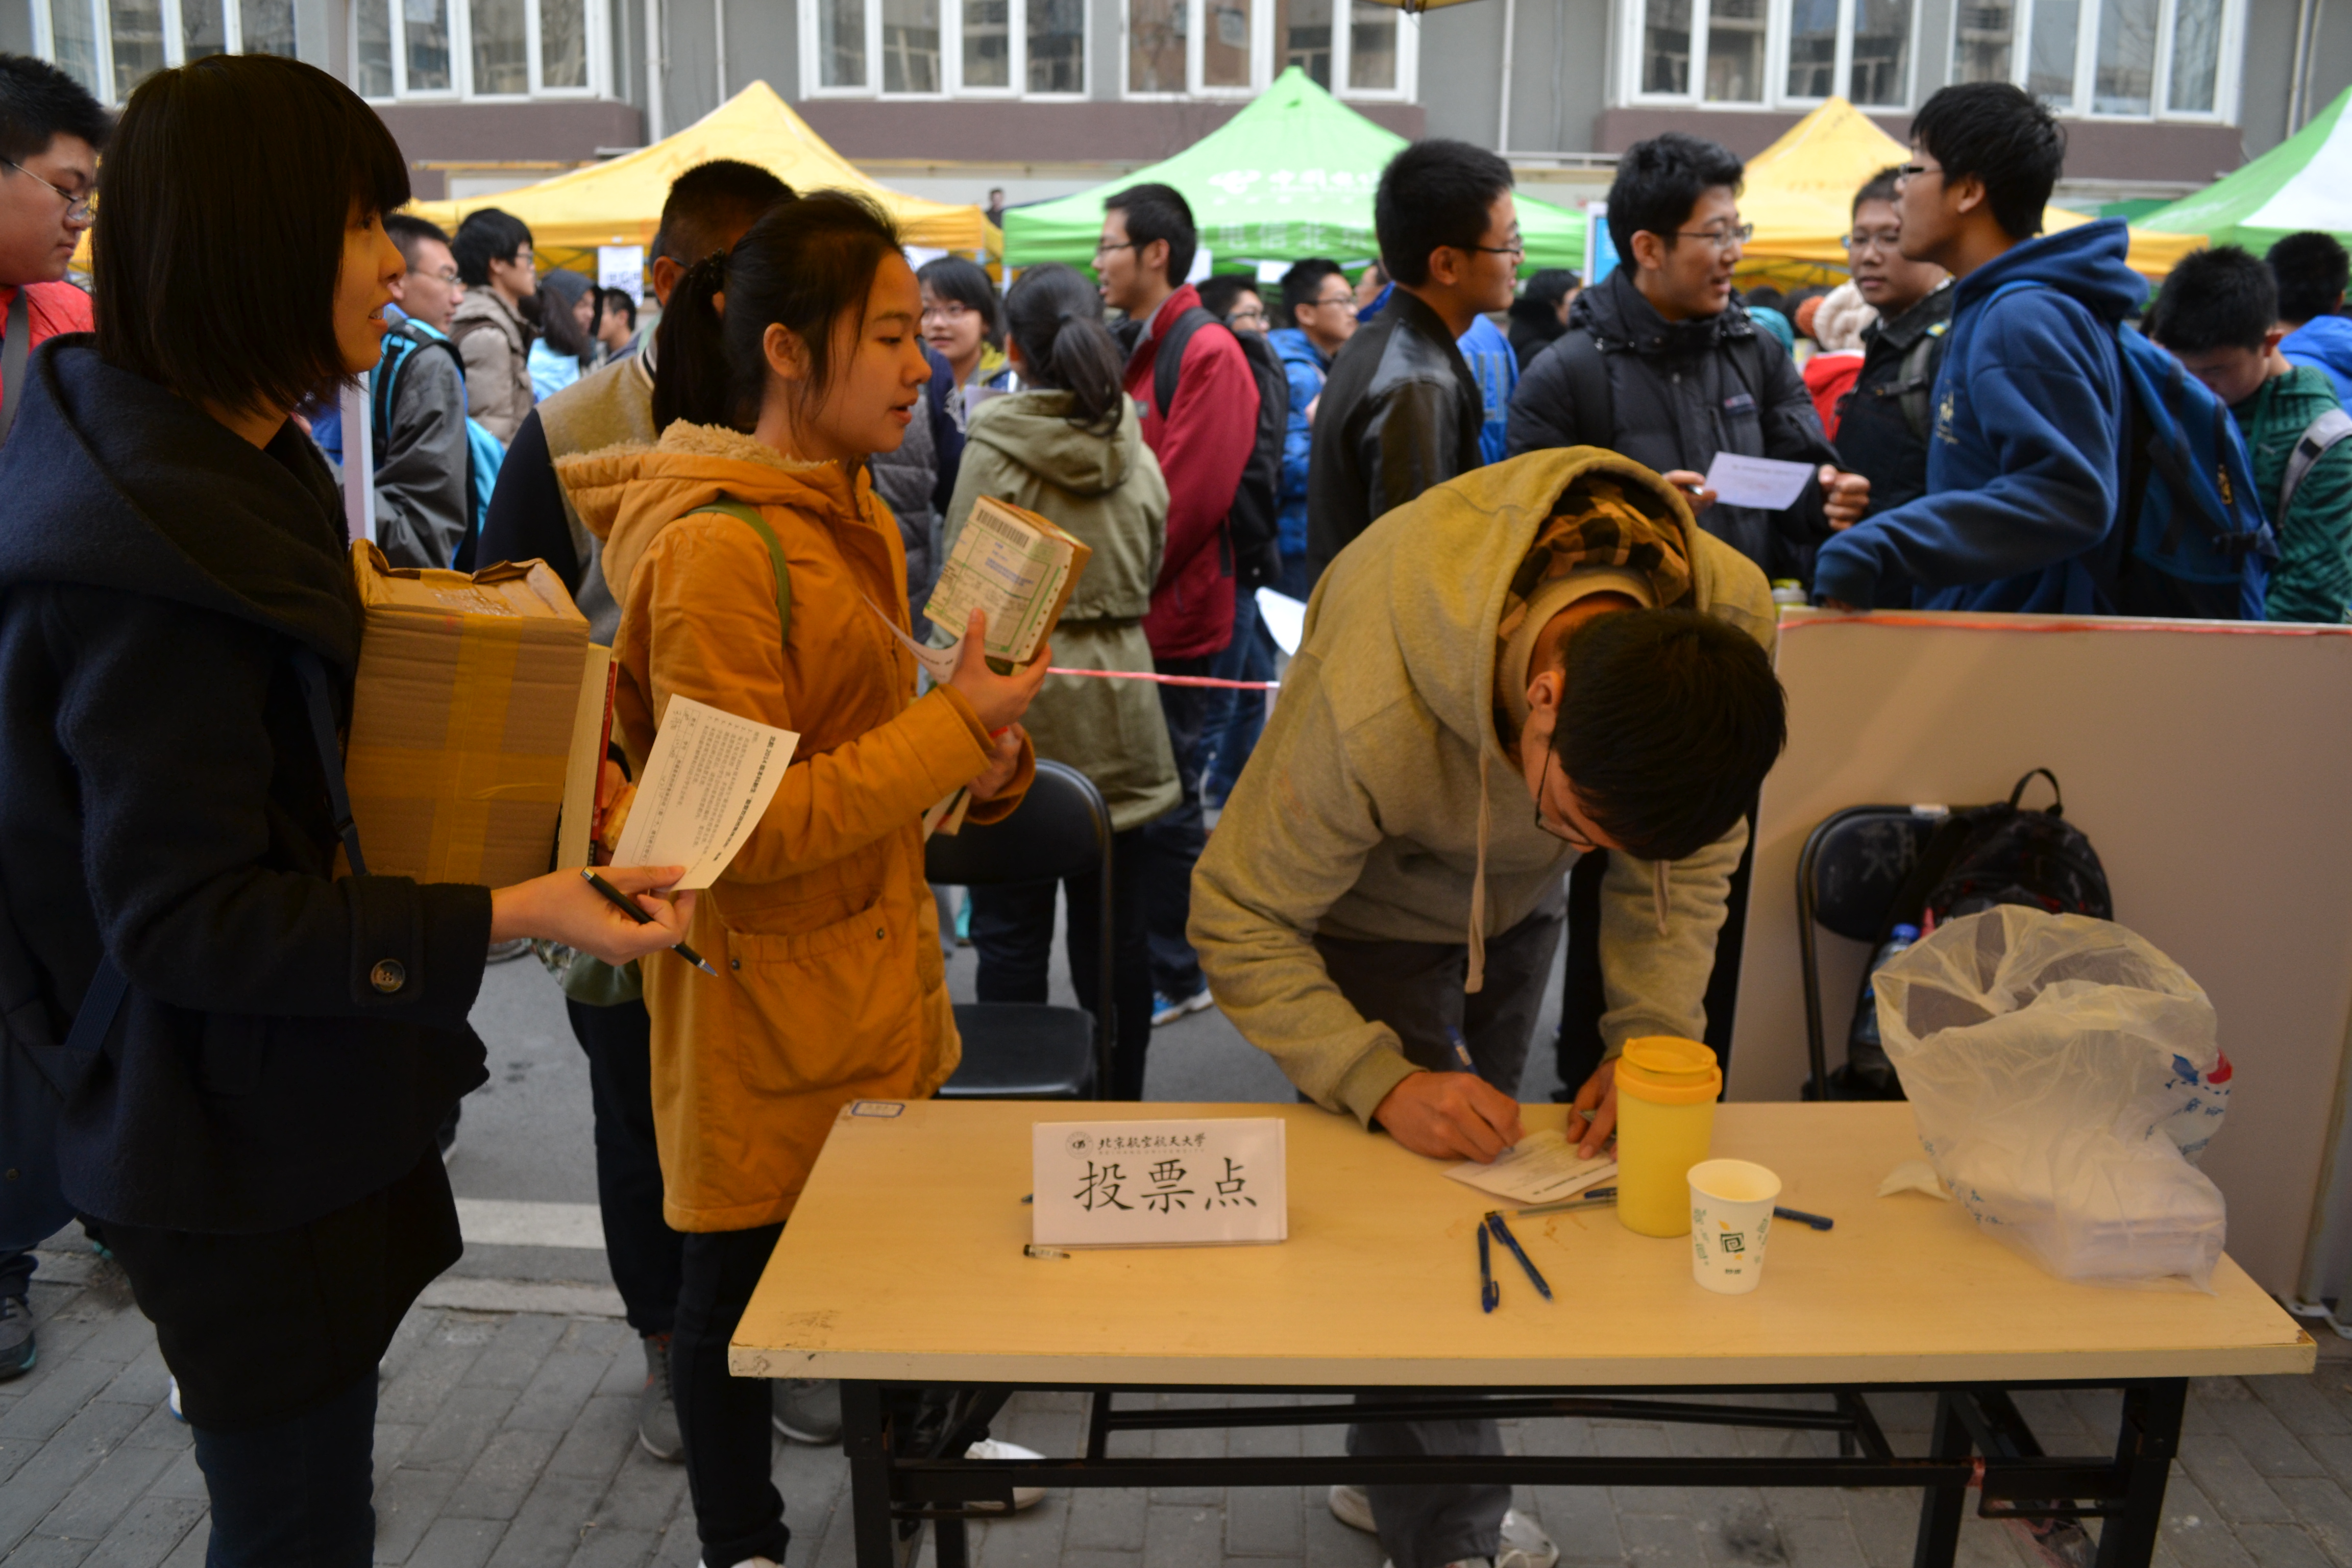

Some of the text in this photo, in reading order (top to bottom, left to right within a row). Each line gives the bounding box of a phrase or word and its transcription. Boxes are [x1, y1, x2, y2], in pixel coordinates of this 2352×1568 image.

[1098, 1133, 1207, 1149] 北京航空航天大学
[1073, 1157, 1258, 1214] 投票点
